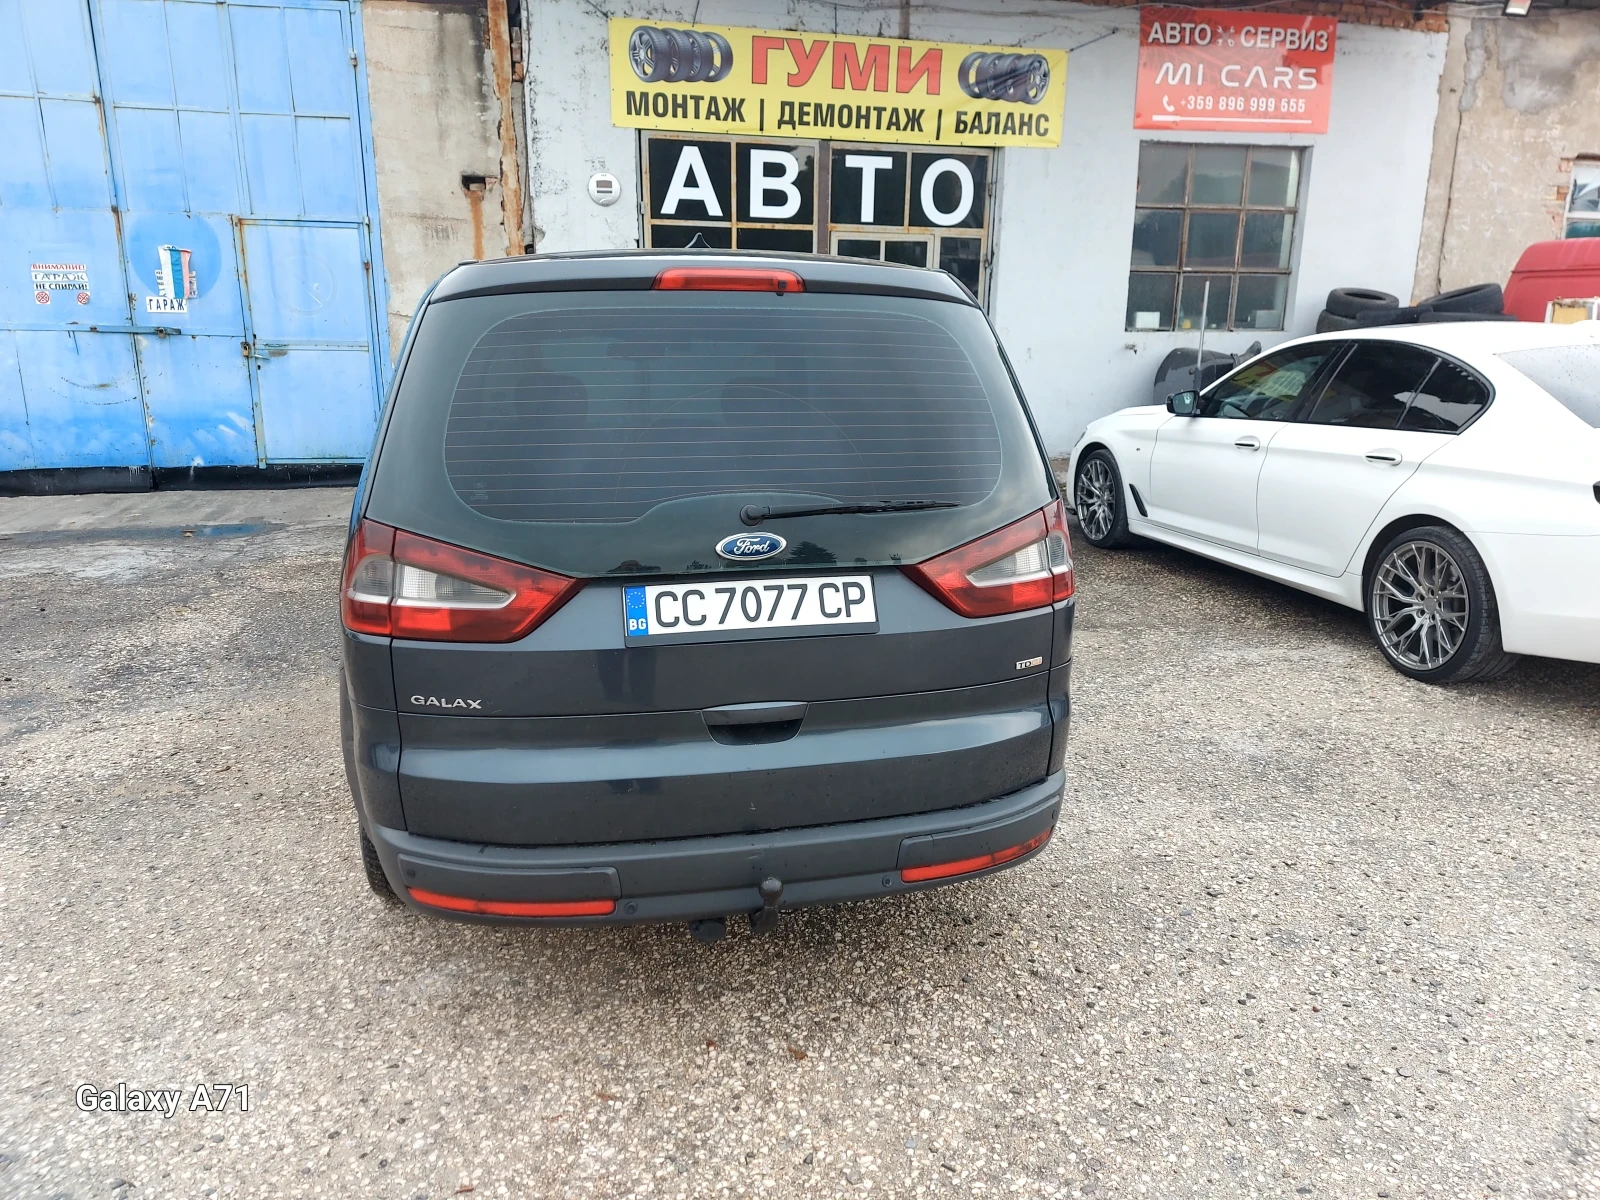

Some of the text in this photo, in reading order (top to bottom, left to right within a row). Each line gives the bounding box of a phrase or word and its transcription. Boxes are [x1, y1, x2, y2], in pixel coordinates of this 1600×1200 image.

[1148, 22, 1329, 52] АВТО СЕРВИЗ
[751, 35, 943, 96] ГУМИ
[1155, 62, 1318, 90] MI CARS
[626, 90, 1050, 136] МОНТАЖ ДЕМОНТАЖ БАЛАНС
[1181, 95, 1306, 113] +359 896 999 555
[660, 145, 975, 226] АВТО
[34, 273, 85, 281] ГАРАЖ
[149, 299, 185, 311] ГАРАЖ
[733, 538, 771, 555] Ford
[715, 583, 808, 625] 7077
[629, 618, 647, 631] BG
[410, 695, 482, 709] GALAX
